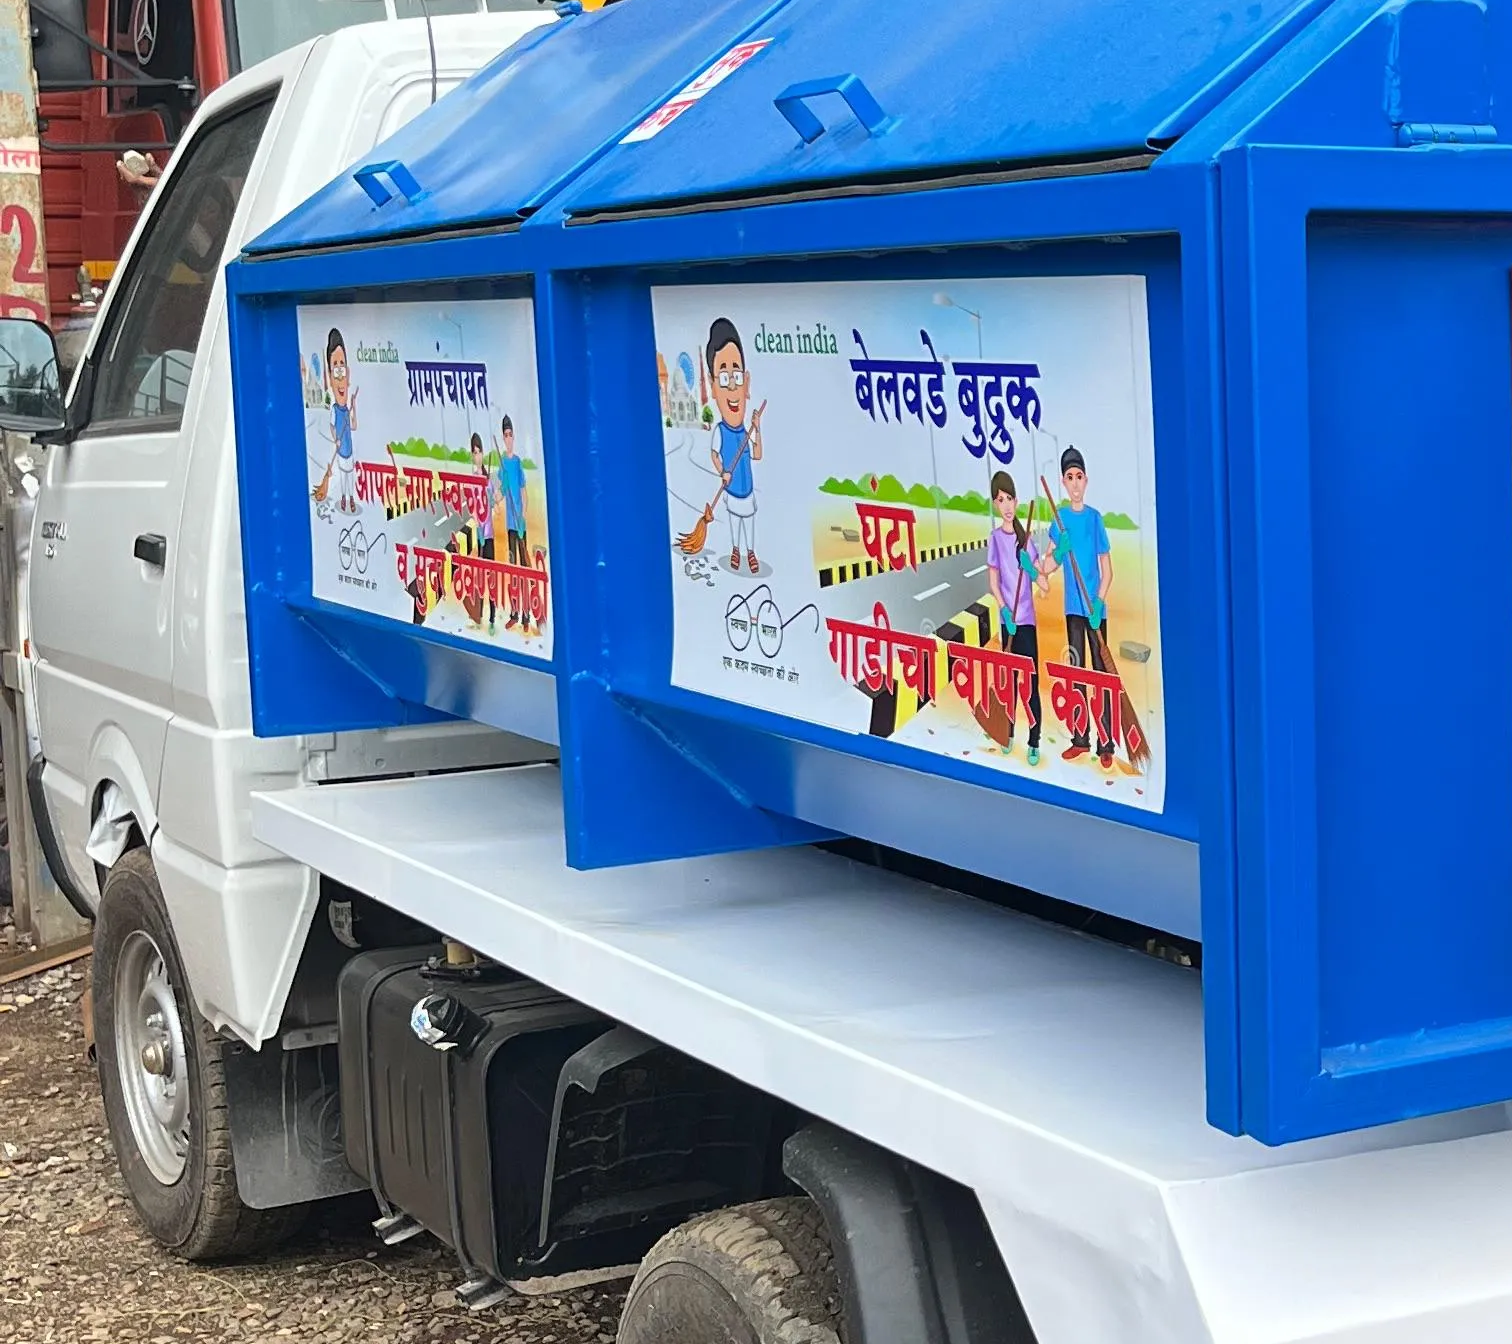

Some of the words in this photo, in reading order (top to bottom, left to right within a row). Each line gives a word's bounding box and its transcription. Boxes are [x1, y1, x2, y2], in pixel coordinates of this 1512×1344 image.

[356, 340, 378, 363] clean
[378, 340, 399, 363] india
[754, 322, 794, 354] clean
[796, 322, 839, 355] india
[404, 340, 489, 410] ग्रामपंचायत
[849, 328, 947, 429] बेलवडे
[825, 601, 939, 704] गाडीचा
[947, 640, 1037, 729] वापर
